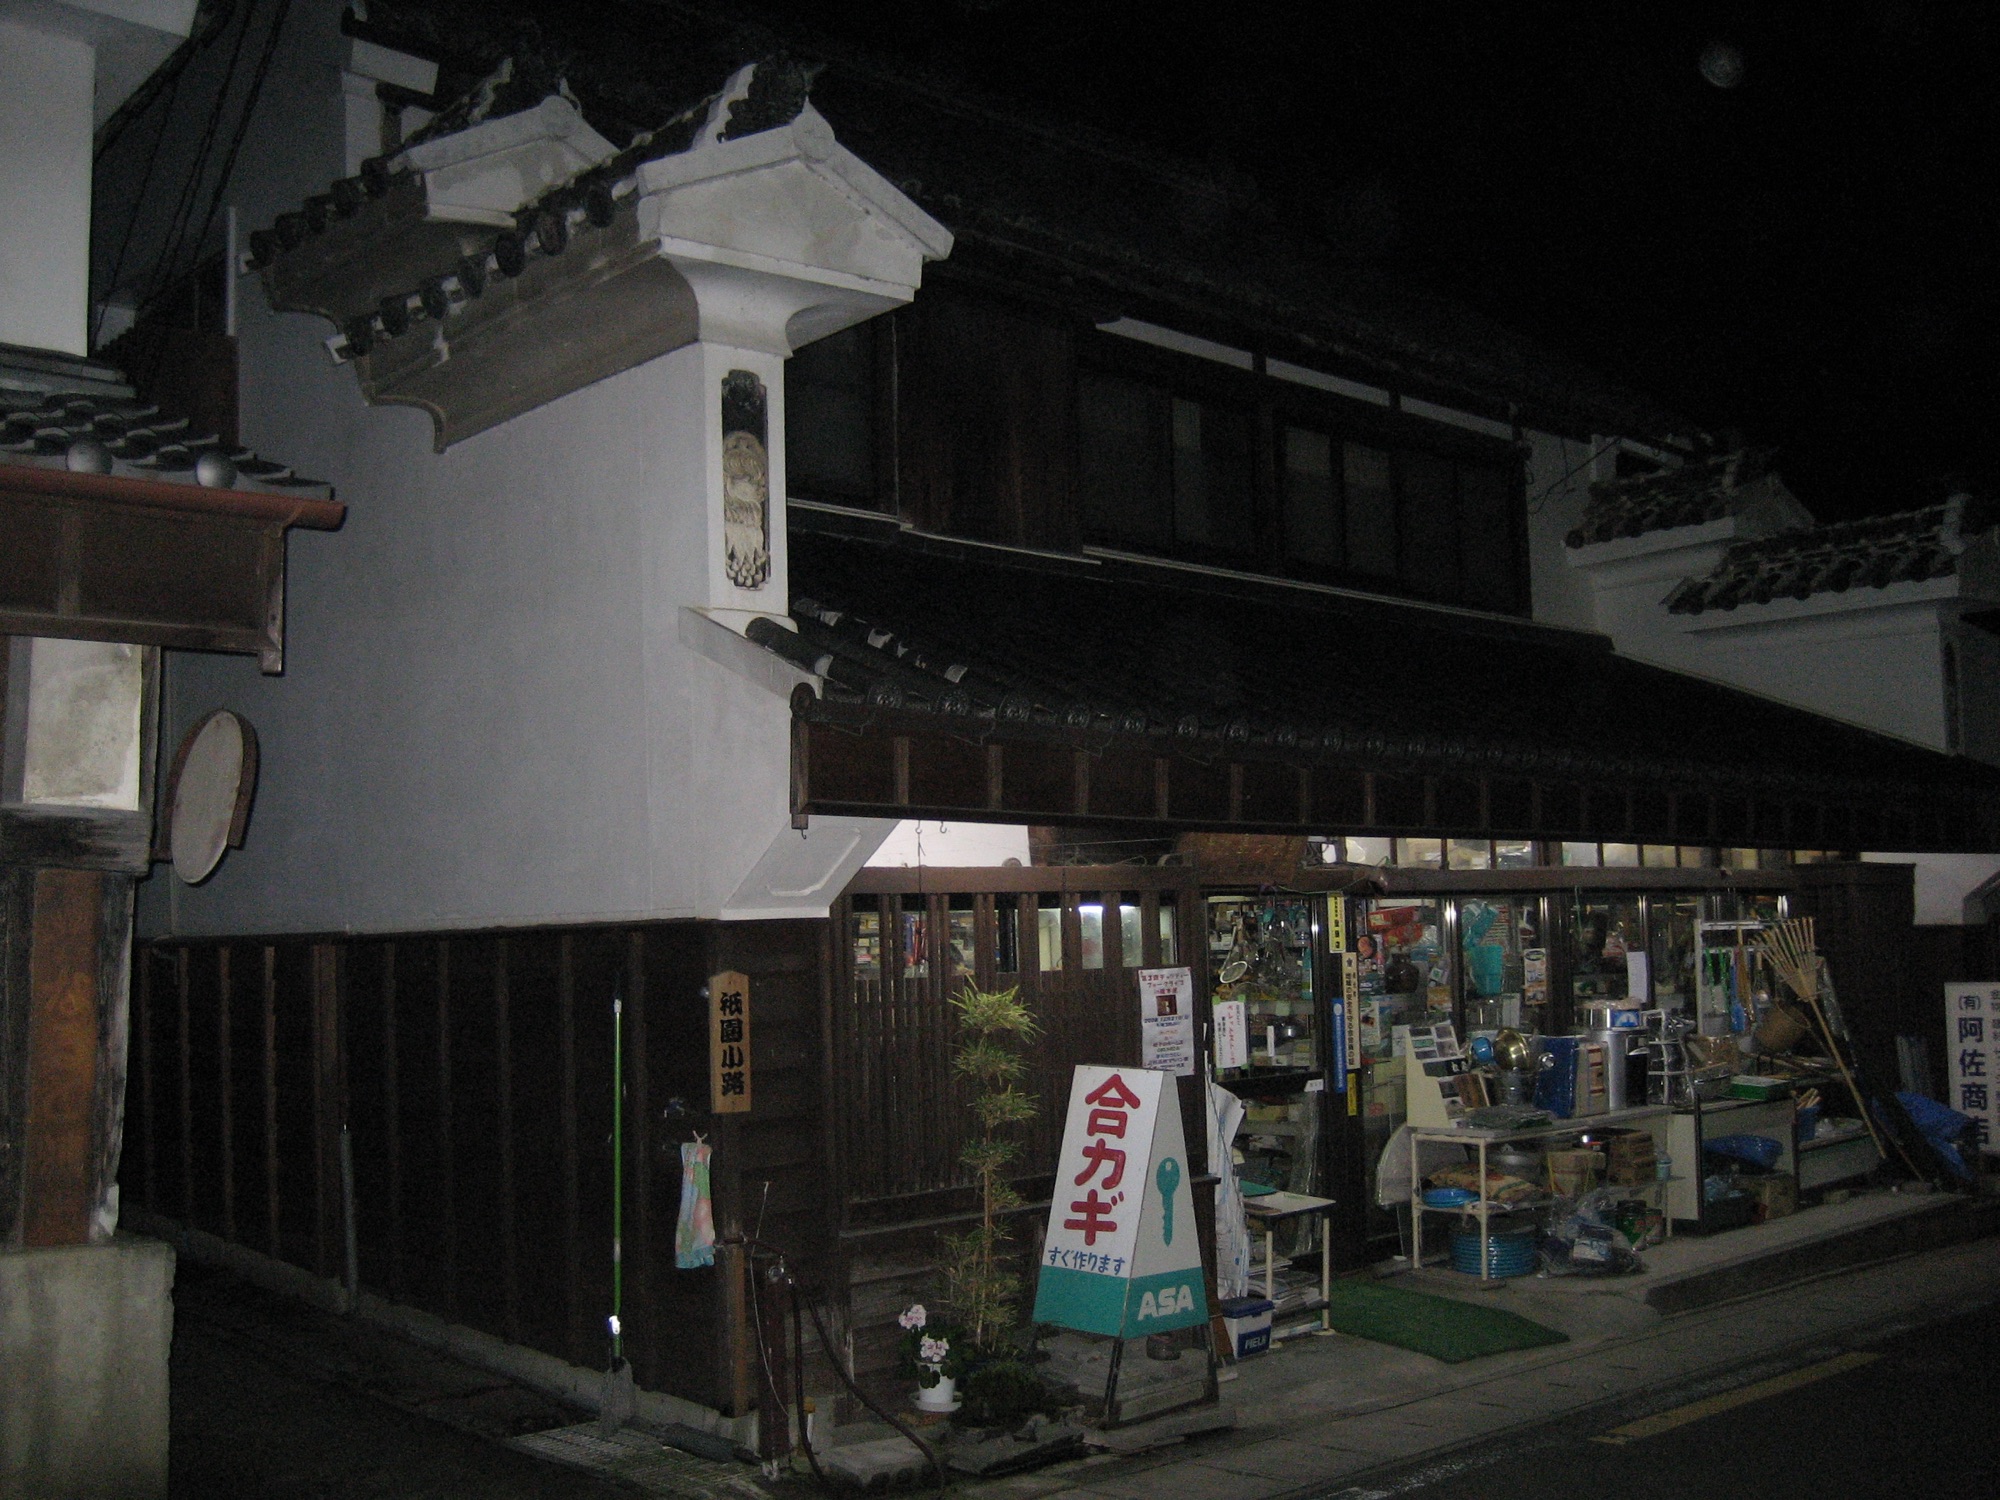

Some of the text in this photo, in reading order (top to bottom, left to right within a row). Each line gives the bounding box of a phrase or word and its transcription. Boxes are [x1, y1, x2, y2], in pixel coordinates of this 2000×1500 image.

[1064, 1073, 1141, 1246] 合カギ
[1047, 1246, 1126, 1276] すぐ作ります
[1138, 1284, 1195, 1321] ASA
